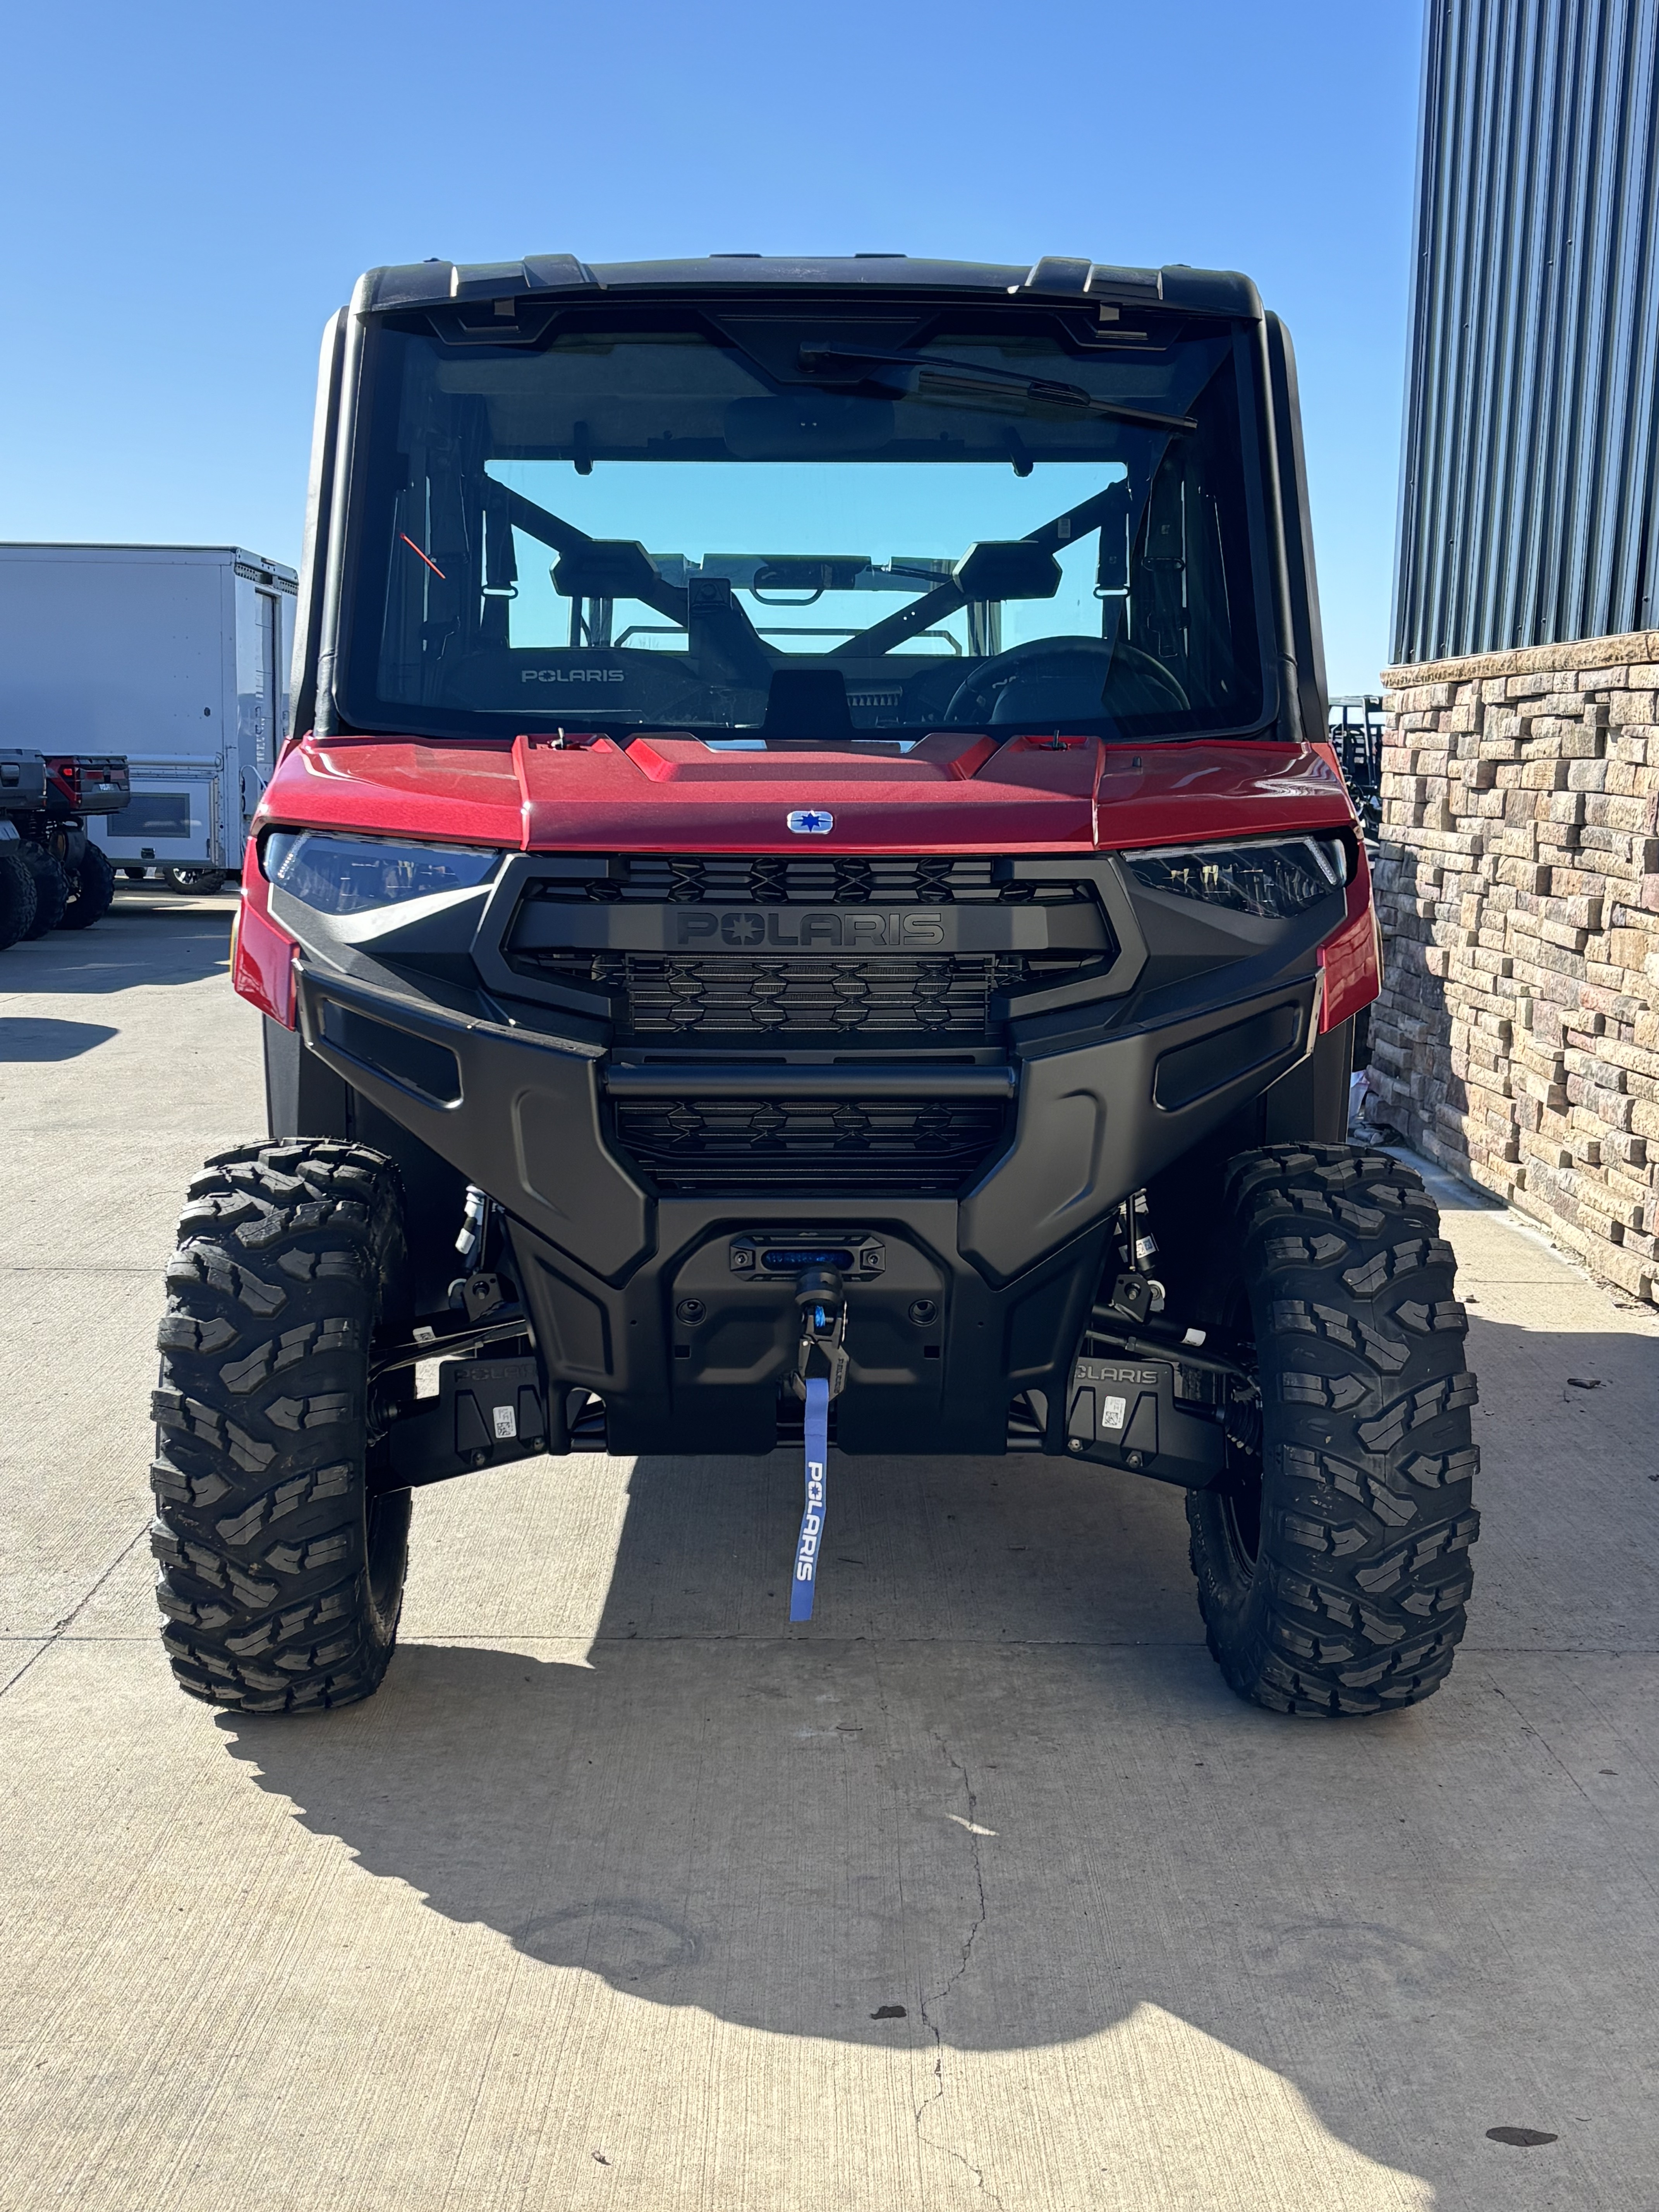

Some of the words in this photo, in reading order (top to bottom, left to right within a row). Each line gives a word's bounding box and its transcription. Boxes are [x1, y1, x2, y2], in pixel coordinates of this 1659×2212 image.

[521, 669, 625, 683] POLARIS
[677, 911, 944, 946] POLARIS
[796, 1462, 823, 1581] POLARIS
